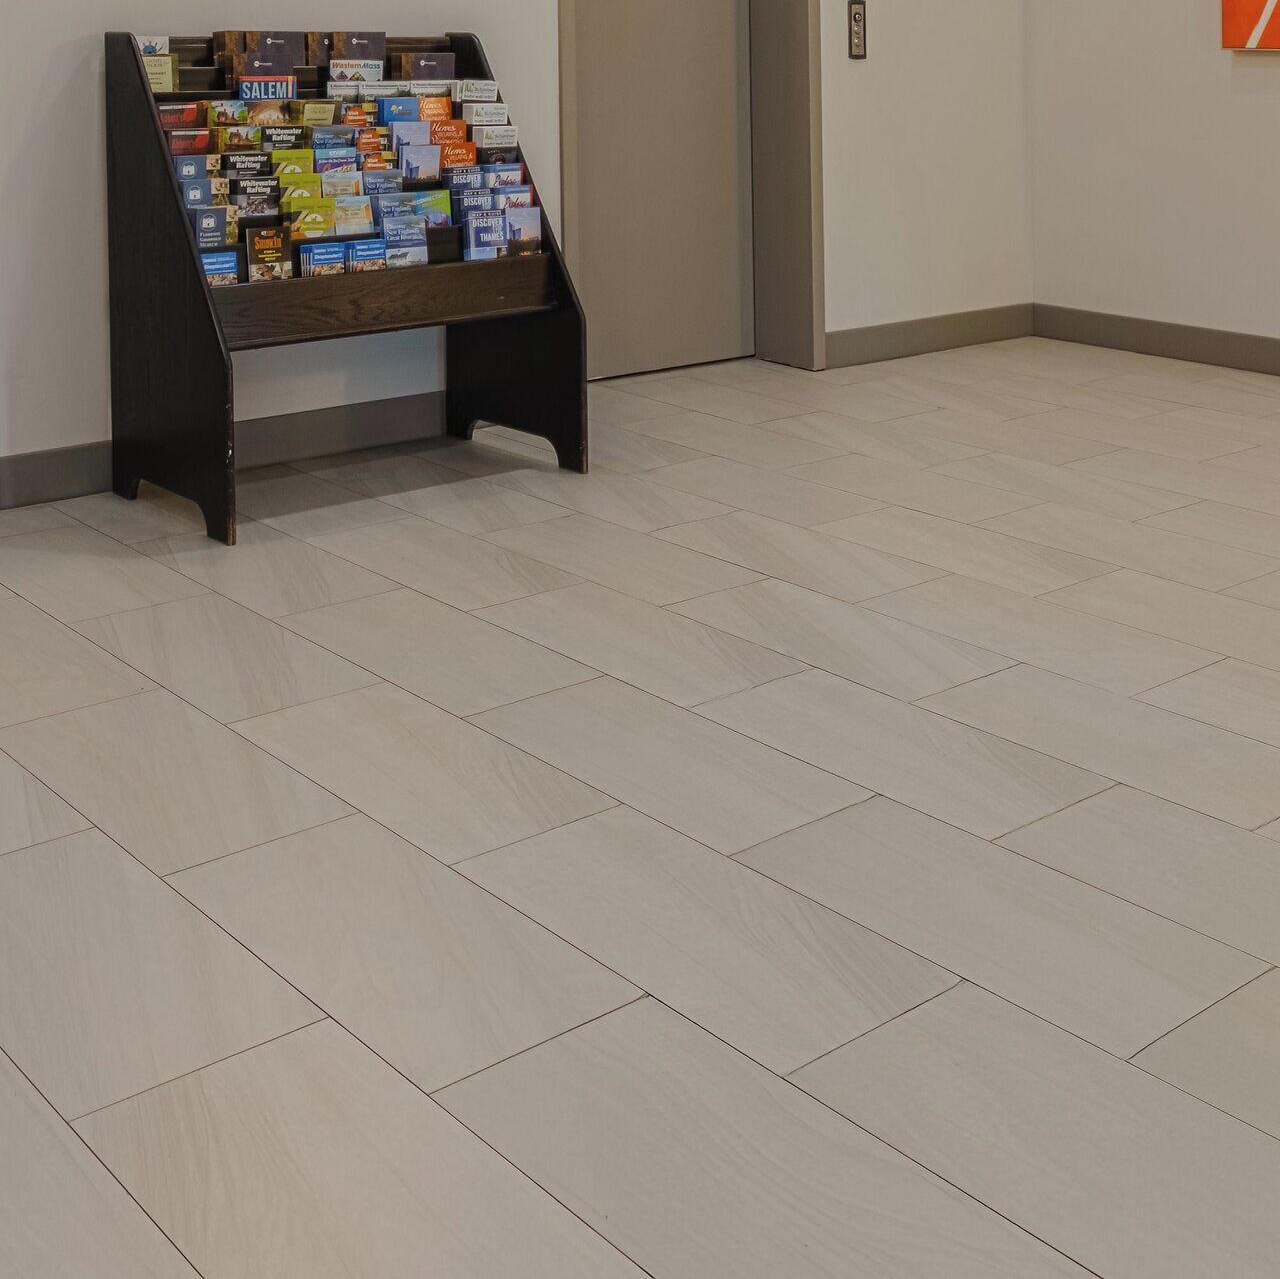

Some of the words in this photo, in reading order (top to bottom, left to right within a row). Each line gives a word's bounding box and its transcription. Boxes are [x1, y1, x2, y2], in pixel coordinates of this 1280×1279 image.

[242, 82, 287, 99] SALEM
[272, 134, 296, 142] Rafting
[452, 174, 481, 184] DISCOVER
[463, 196, 492, 206] DISCOVER
[472, 218, 503, 227] DISCOVER
